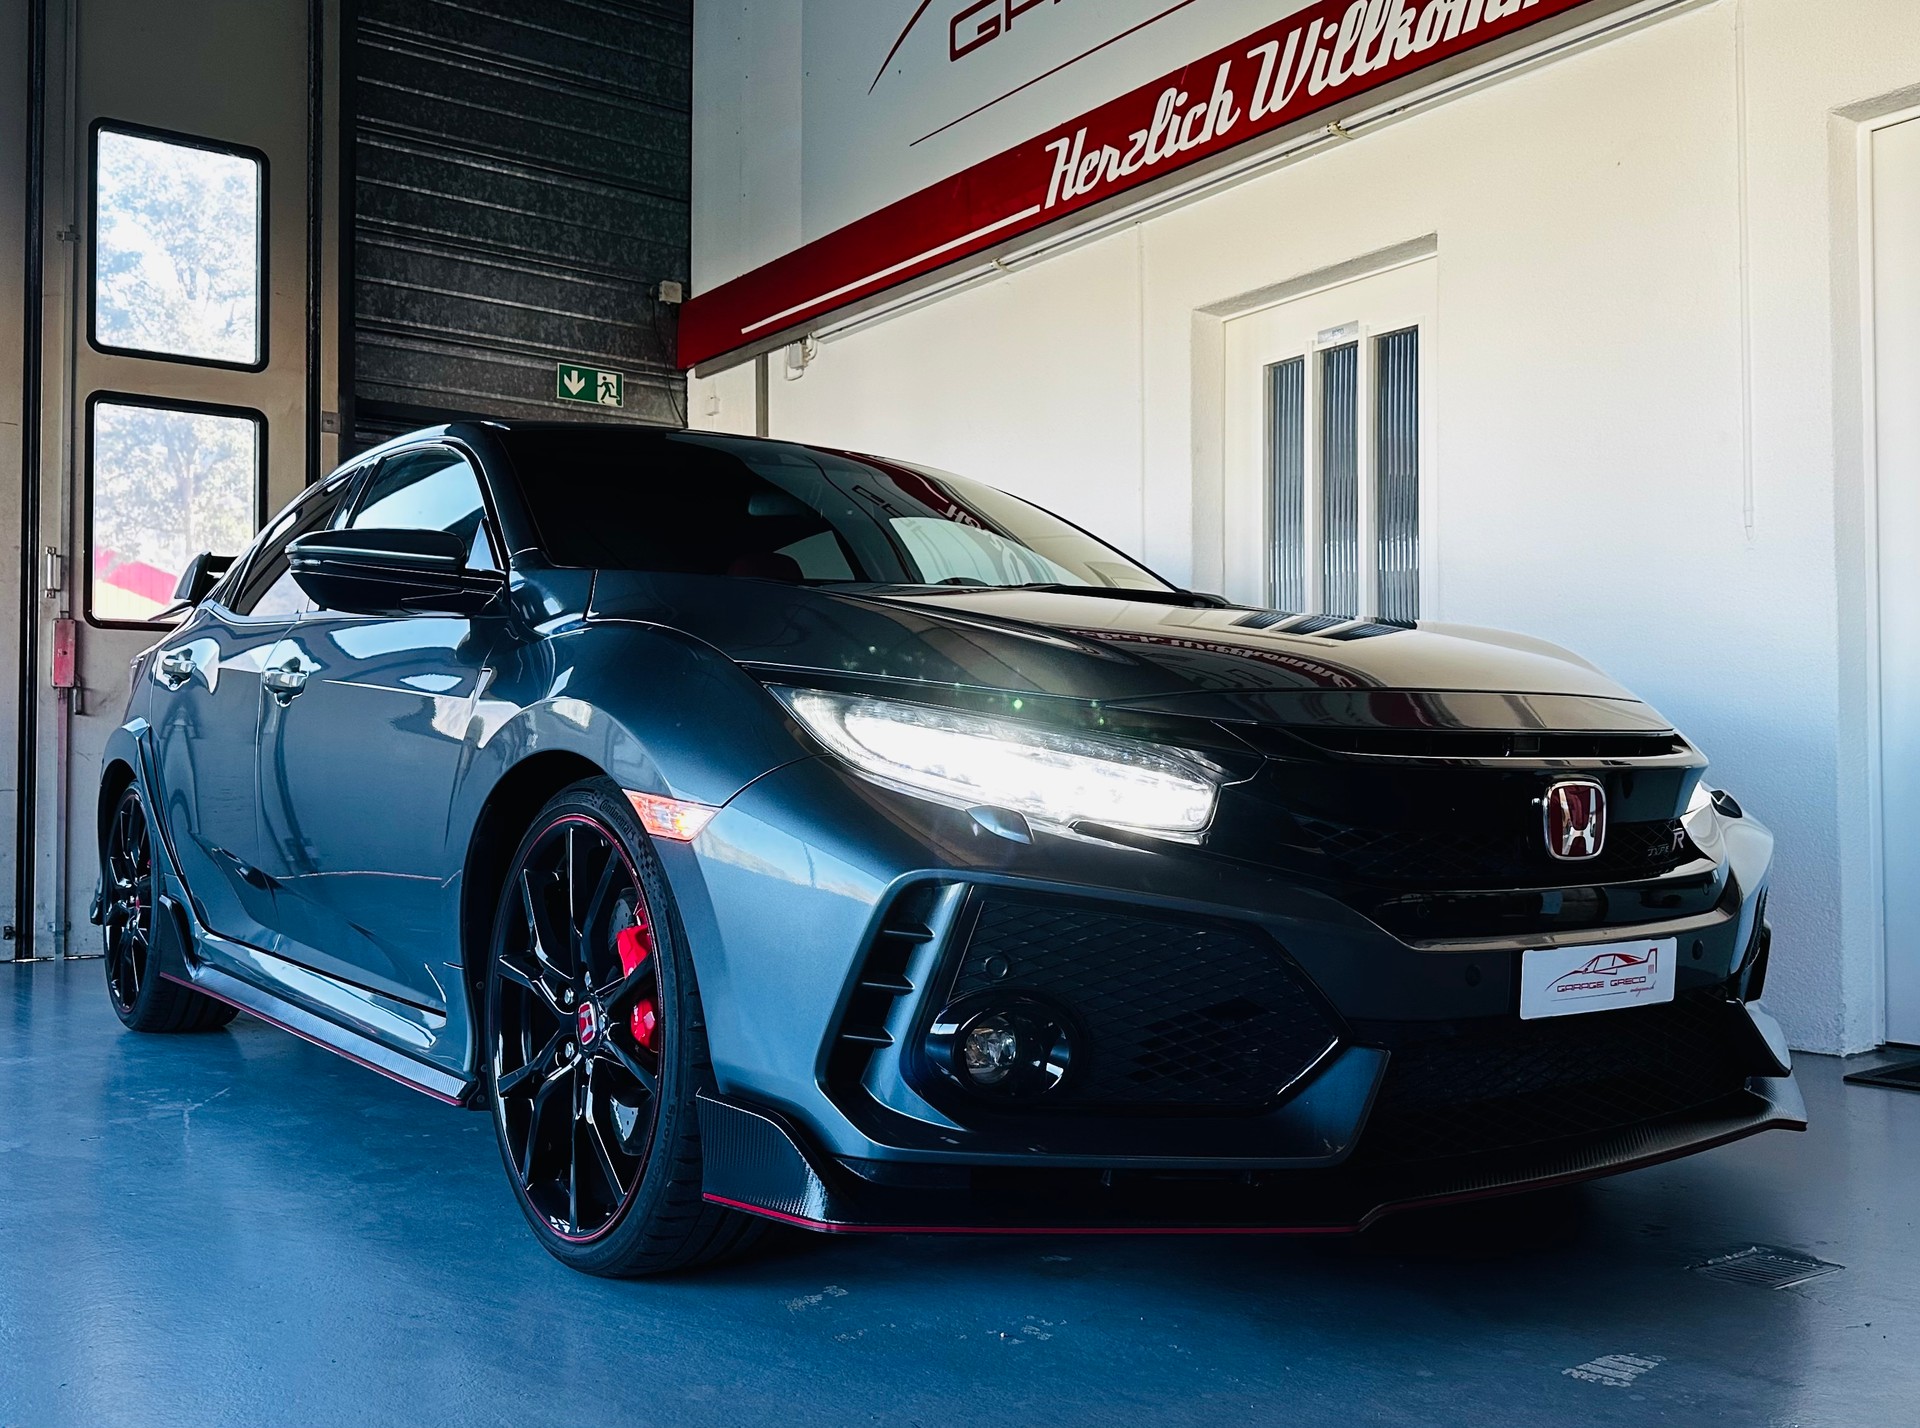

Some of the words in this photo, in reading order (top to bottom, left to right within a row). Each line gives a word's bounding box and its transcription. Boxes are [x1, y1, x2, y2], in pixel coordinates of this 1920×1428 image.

[1044, 59, 1241, 209] Herzlich
[599, 799, 633, 836] Continental
[1669, 827, 1685, 852] R
[1557, 981, 1604, 992] GARAGE
